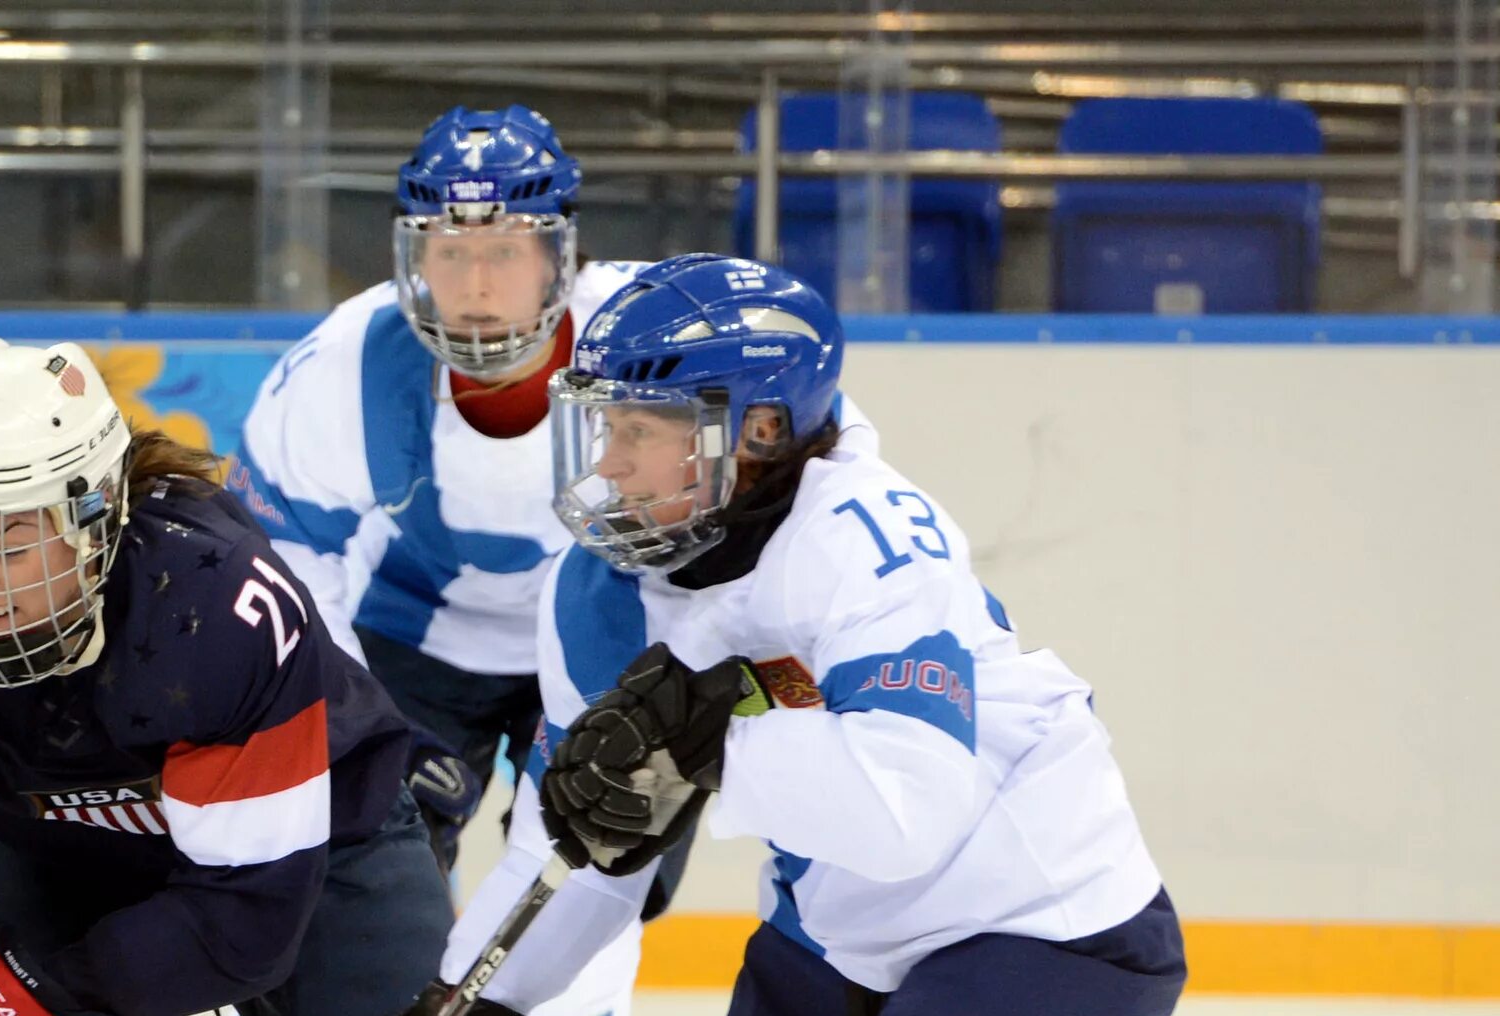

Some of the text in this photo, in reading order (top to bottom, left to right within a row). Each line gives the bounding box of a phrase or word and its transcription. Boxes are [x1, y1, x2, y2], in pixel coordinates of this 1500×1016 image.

[742, 345, 787, 357] Reebok
[831, 489, 951, 580] 13
[232, 555, 309, 668] 21
[49, 787, 143, 807] USA
